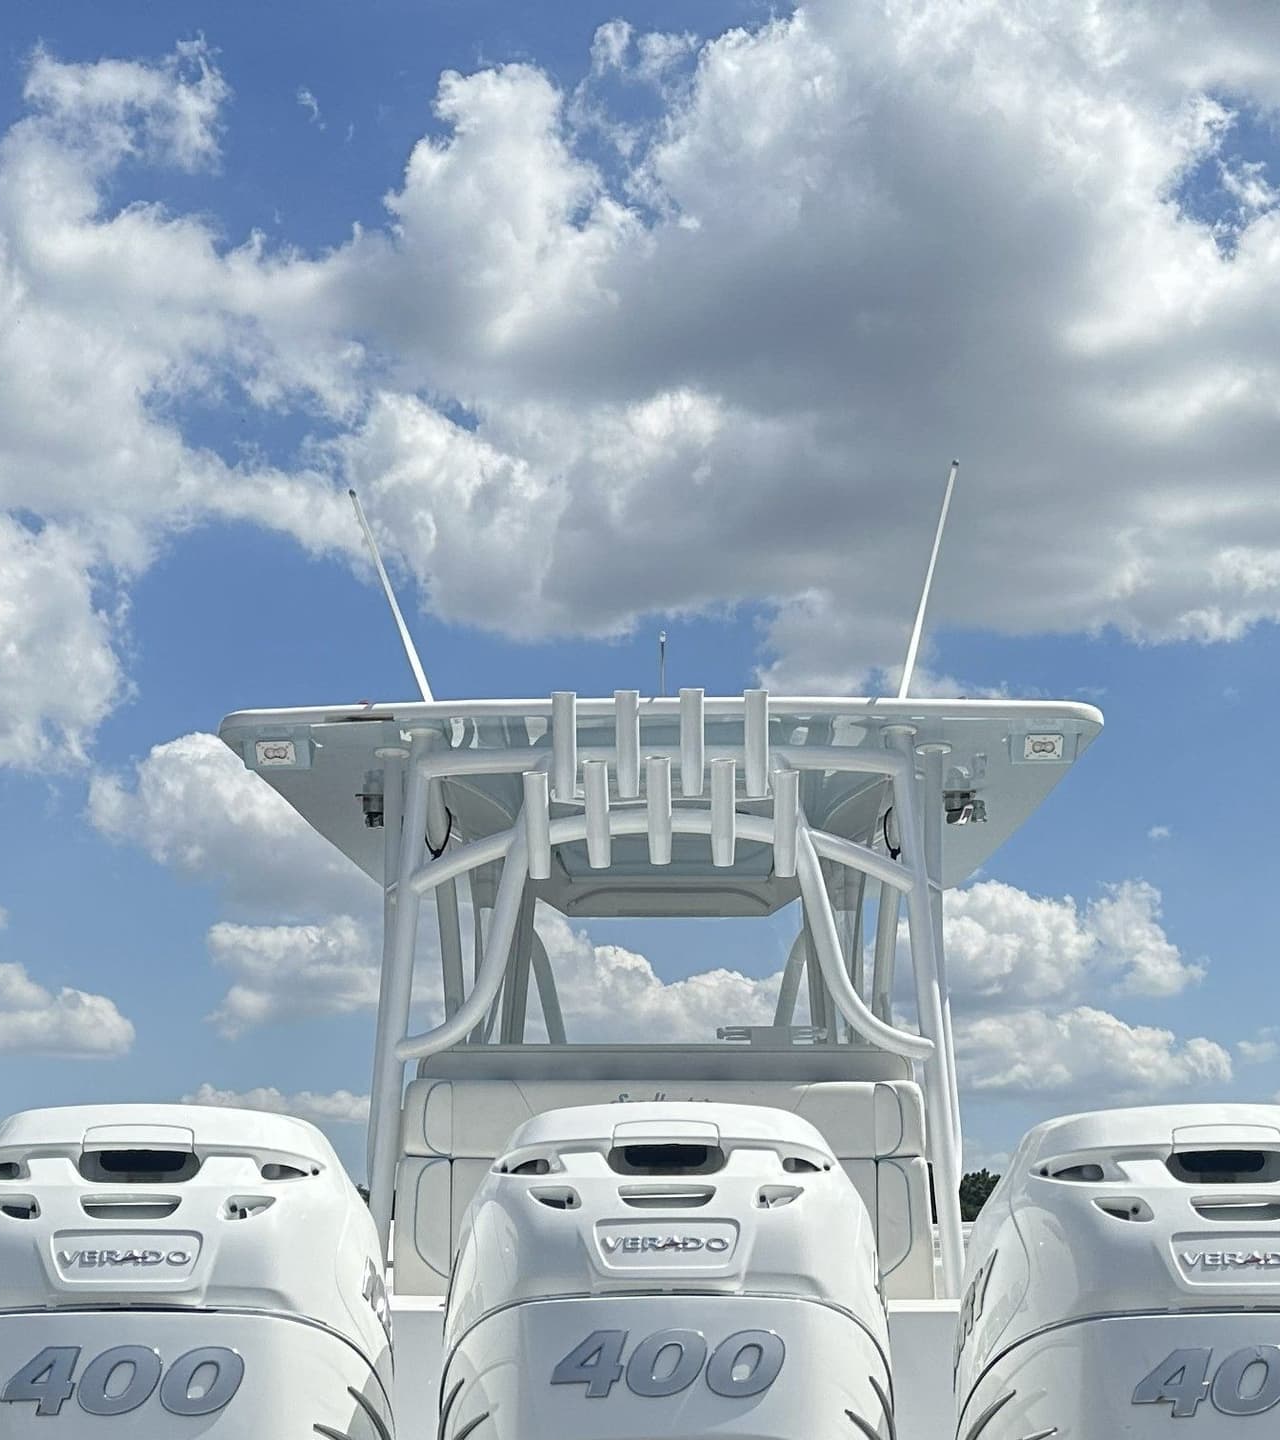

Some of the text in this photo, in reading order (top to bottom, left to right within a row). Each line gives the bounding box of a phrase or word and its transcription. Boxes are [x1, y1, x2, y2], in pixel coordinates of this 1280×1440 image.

[56, 1249, 191, 1269] VERADO
[600, 1234, 731, 1255] VERADO
[0, 1344, 246, 1417] 400
[550, 1328, 787, 1399] 400
